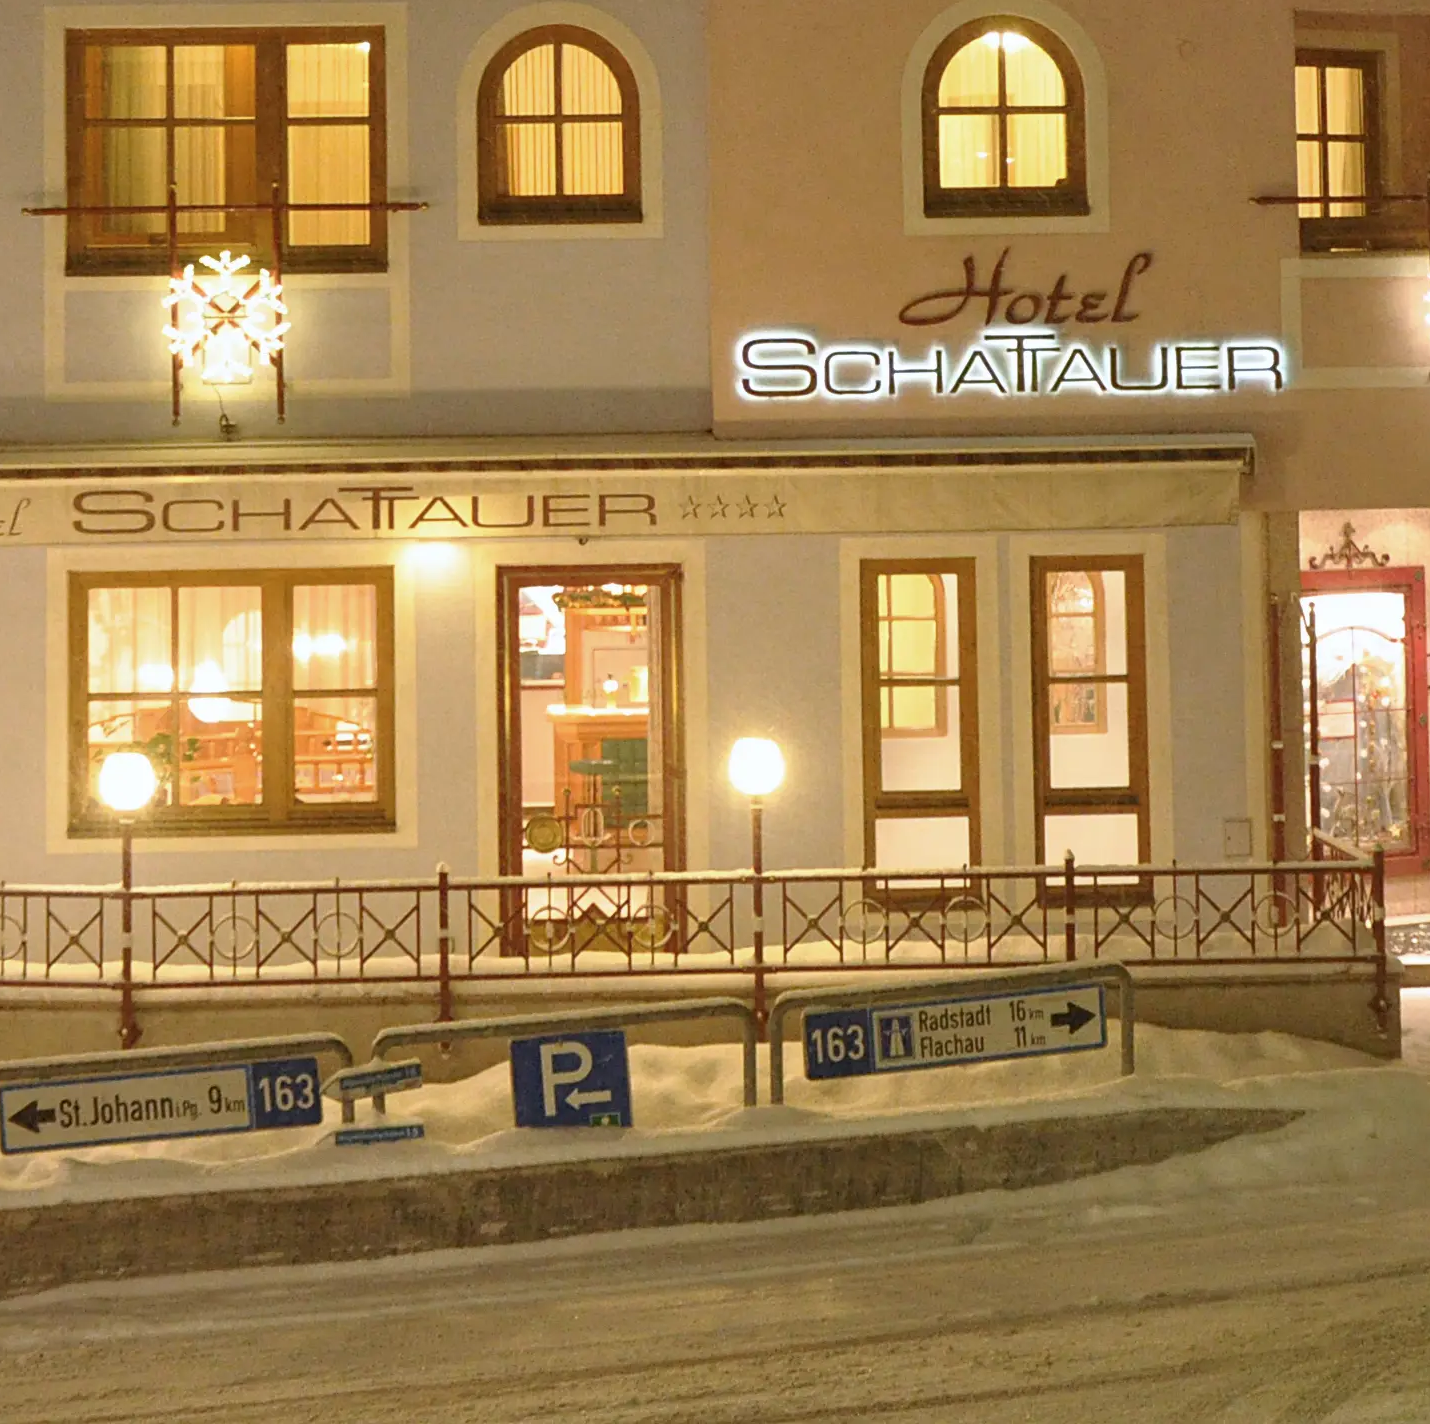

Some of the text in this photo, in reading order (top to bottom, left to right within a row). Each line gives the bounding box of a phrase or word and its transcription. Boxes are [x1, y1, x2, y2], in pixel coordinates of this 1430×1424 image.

[898, 247, 1155, 326] Hotel
[741, 333, 1284, 397] SCHATTAUER
[72, 486, 657, 535] SCHATTAUER
[919, 1000, 1045, 1033] Radstadt 16 km
[811, 1025, 865, 1064] 163
[920, 1026, 1046, 1058] Flachau 11 km
[259, 1073, 315, 1113] 163
[540, 1041, 593, 1116] P
[91, 1094, 174, 1125] Johann
[208, 1085, 223, 1114] 9
[224, 1097, 246, 1113] km
